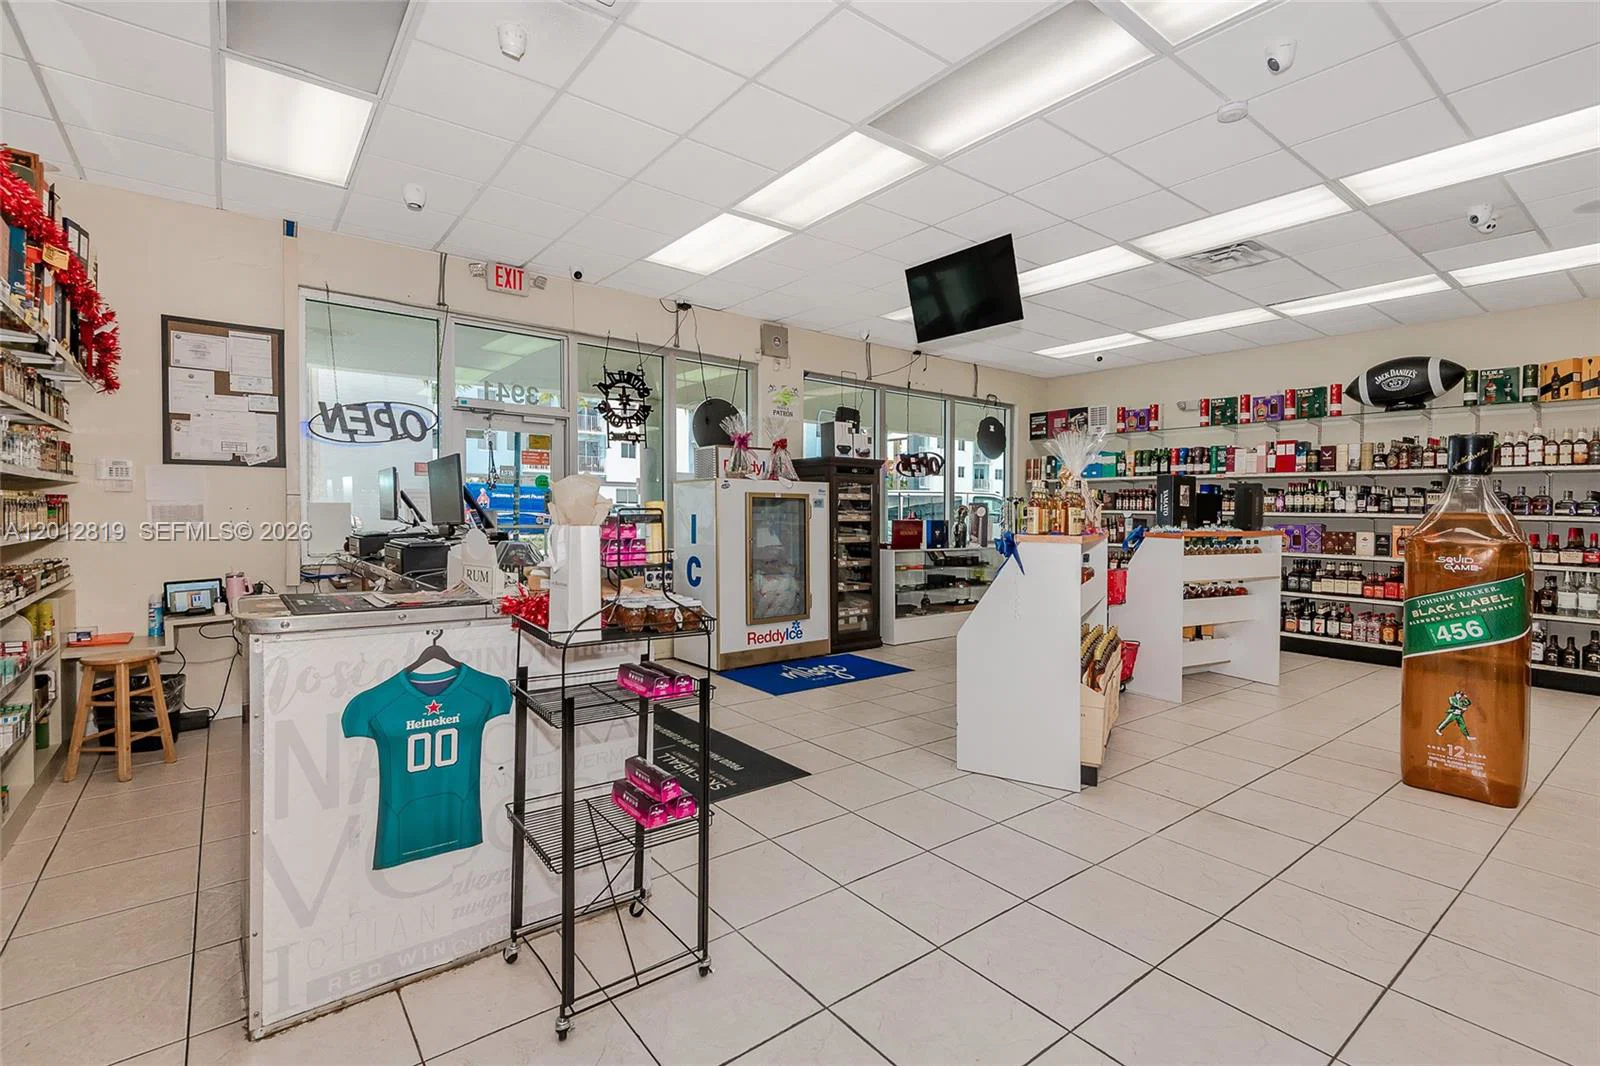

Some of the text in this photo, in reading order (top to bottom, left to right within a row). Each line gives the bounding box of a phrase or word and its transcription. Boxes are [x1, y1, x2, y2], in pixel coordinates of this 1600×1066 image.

[495, 265, 525, 291] EXIT
[1374, 371, 1390, 385] JACK
[1435, 554, 1474, 566] SQUID
[1443, 563, 1483, 573] GAME
[466, 568, 489, 584] RUM
[1411, 593, 1510, 618] BLACK LABEL
[1417, 585, 1497, 608] JOHNNIE WALKER
[1444, 609, 1477, 620] SCOTCH
[1480, 602, 1514, 613] WHISKY
[1436, 620, 1485, 643] 456
[406, 713, 459, 731] Heineken
[407, 728, 458, 773] 00
[1446, 744, 1465, 759] 12
[328, 963, 382, 992] RED
